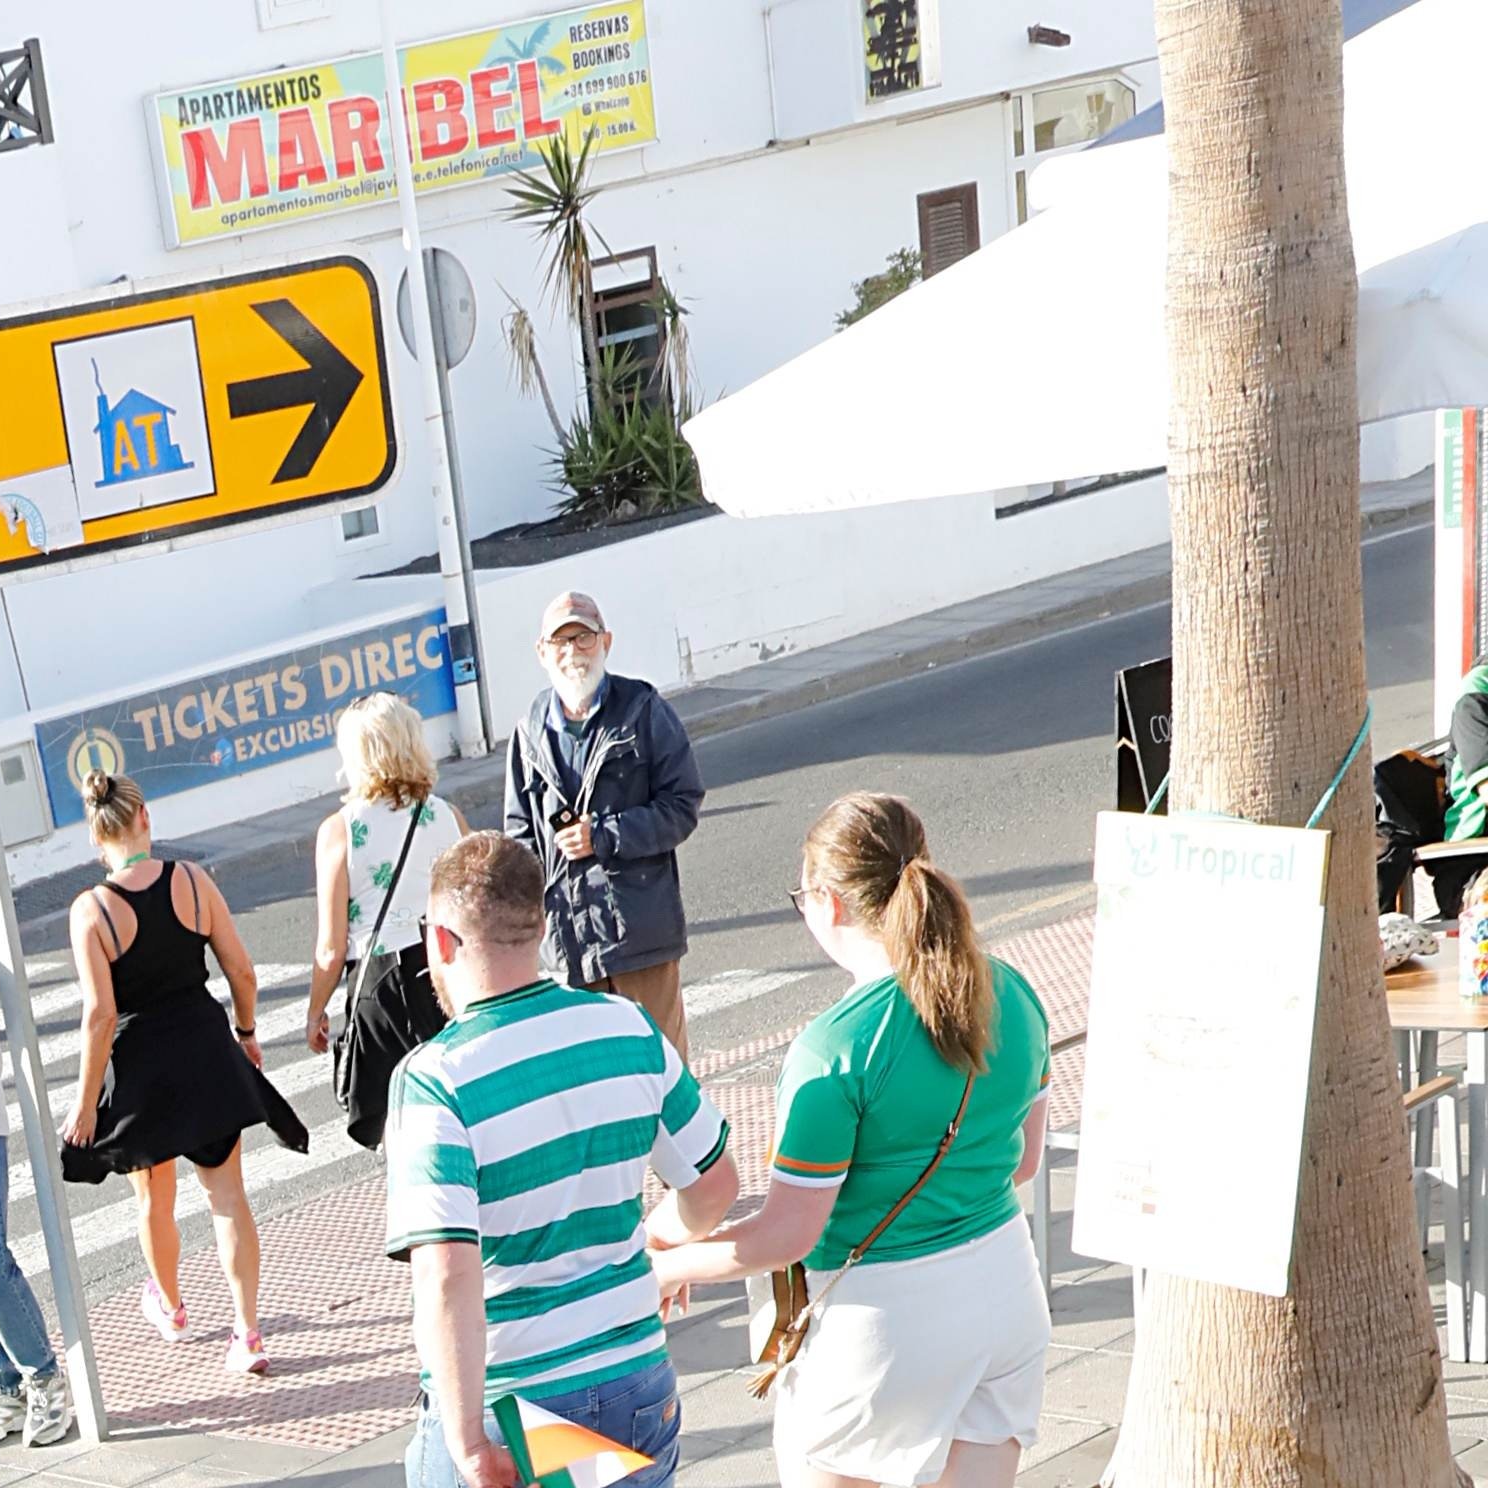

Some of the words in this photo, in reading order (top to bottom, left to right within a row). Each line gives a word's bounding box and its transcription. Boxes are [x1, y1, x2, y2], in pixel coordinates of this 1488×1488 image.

[569, 15, 629, 44] RESERVAS
[572, 42, 630, 70] BOOKINGS
[178, 74, 322, 128] APARTAMENTOS
[181, 59, 561, 211] MARBEL
[113, 412, 164, 475] AT
[133, 664, 308, 753] TICKETS
[320, 622, 449, 691] DIREC
[1170, 832, 1295, 888] Tropical
